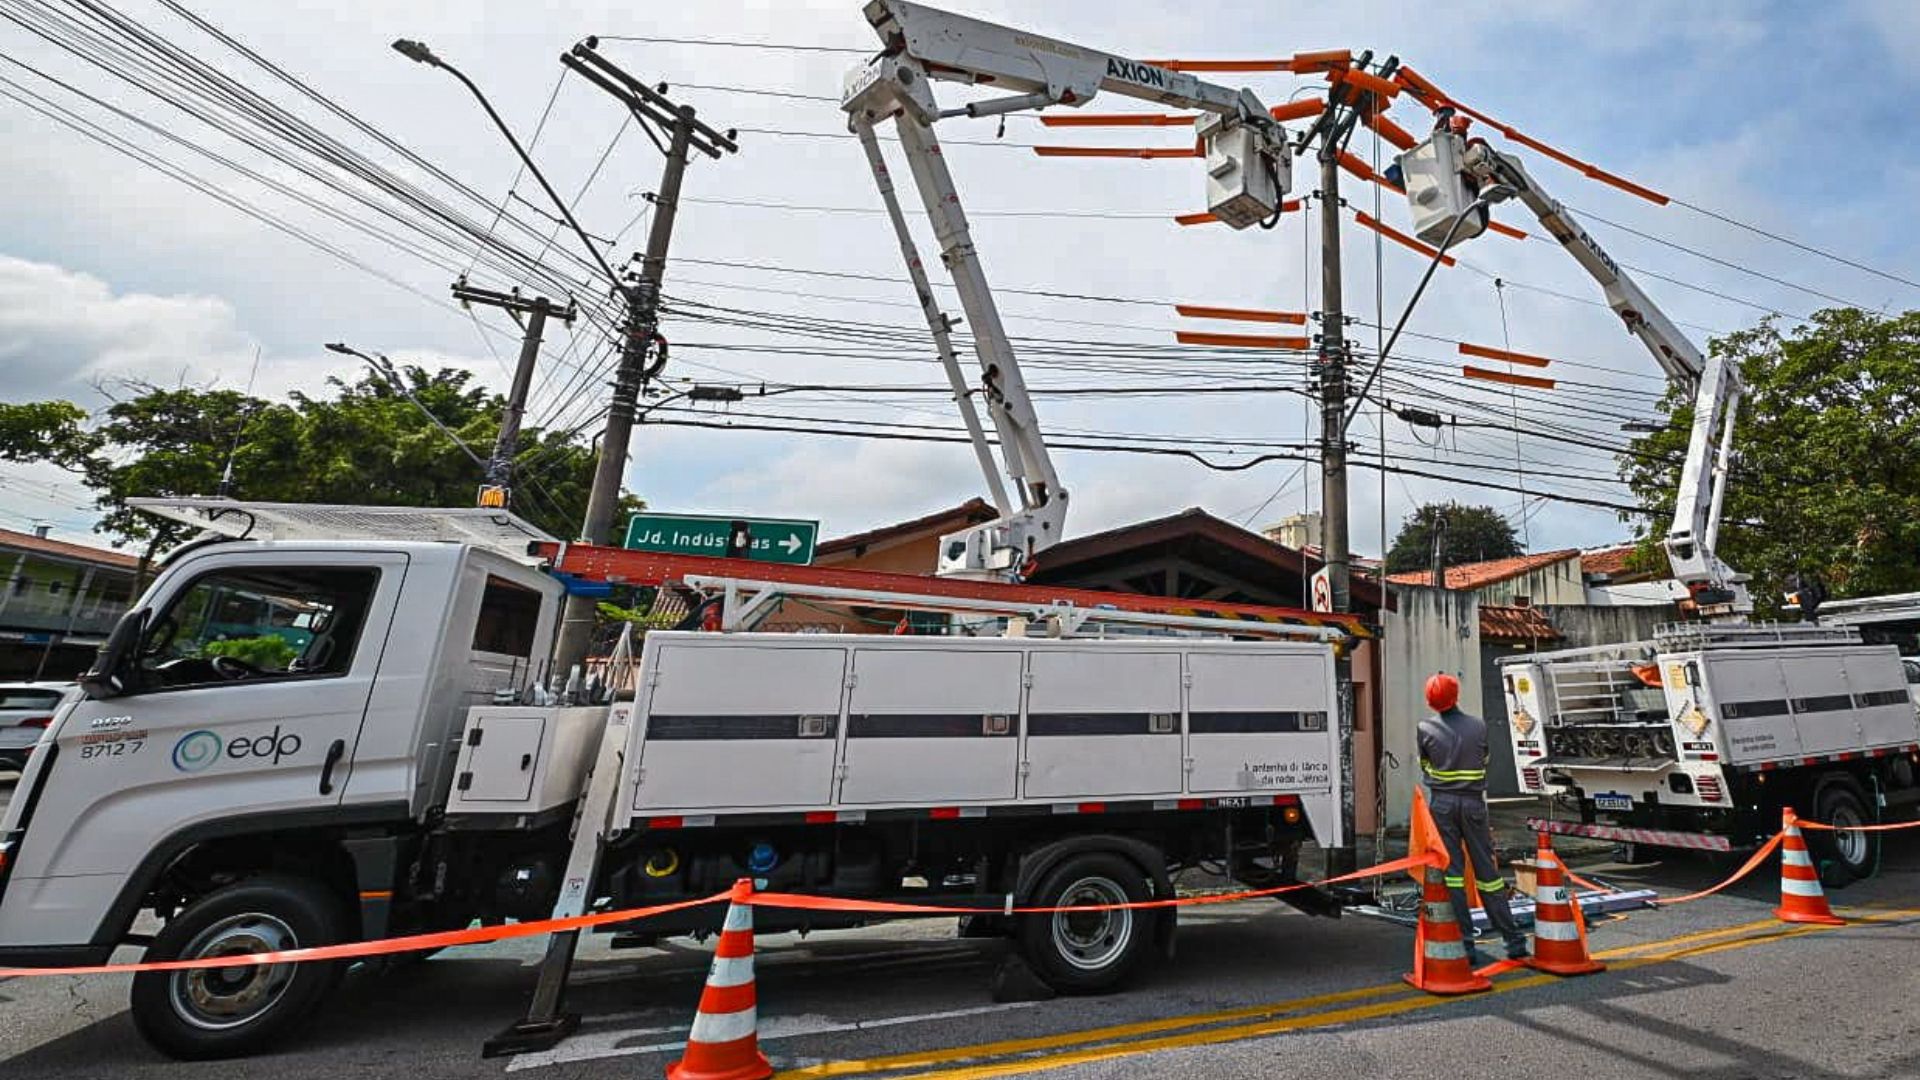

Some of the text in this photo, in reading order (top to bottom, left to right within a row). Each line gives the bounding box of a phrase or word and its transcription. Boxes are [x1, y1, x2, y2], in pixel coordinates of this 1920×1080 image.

[1106, 57, 1164, 88] AXION
[1580, 231, 1620, 276] AXION
[637, 530, 771, 550] Jd. Indúsas
[227, 725, 302, 765] edp
[1218, 797, 1246, 808] NEXT
